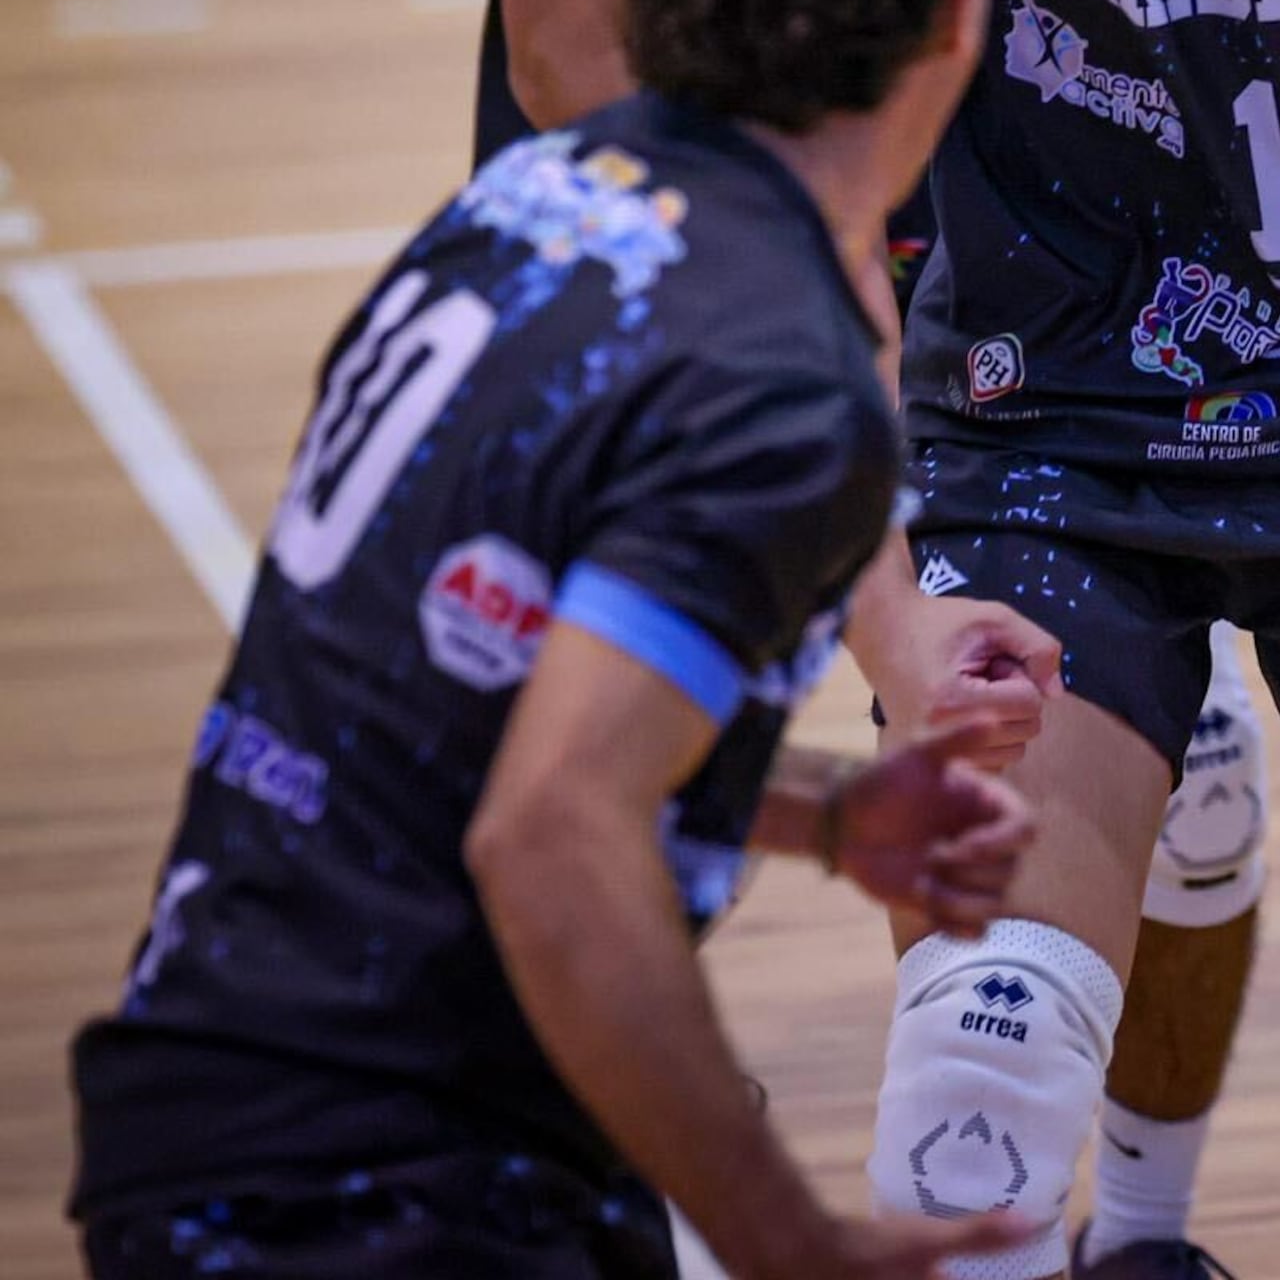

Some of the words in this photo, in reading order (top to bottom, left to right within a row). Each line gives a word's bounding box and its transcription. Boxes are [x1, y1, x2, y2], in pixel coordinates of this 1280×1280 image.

[975, 349, 1010, 386] PH
[266, 267, 498, 590] 10
[1182, 423, 1239, 443] CENTRO
[1243, 426, 1262, 442] DE
[959, 1009, 1029, 1043] errea
